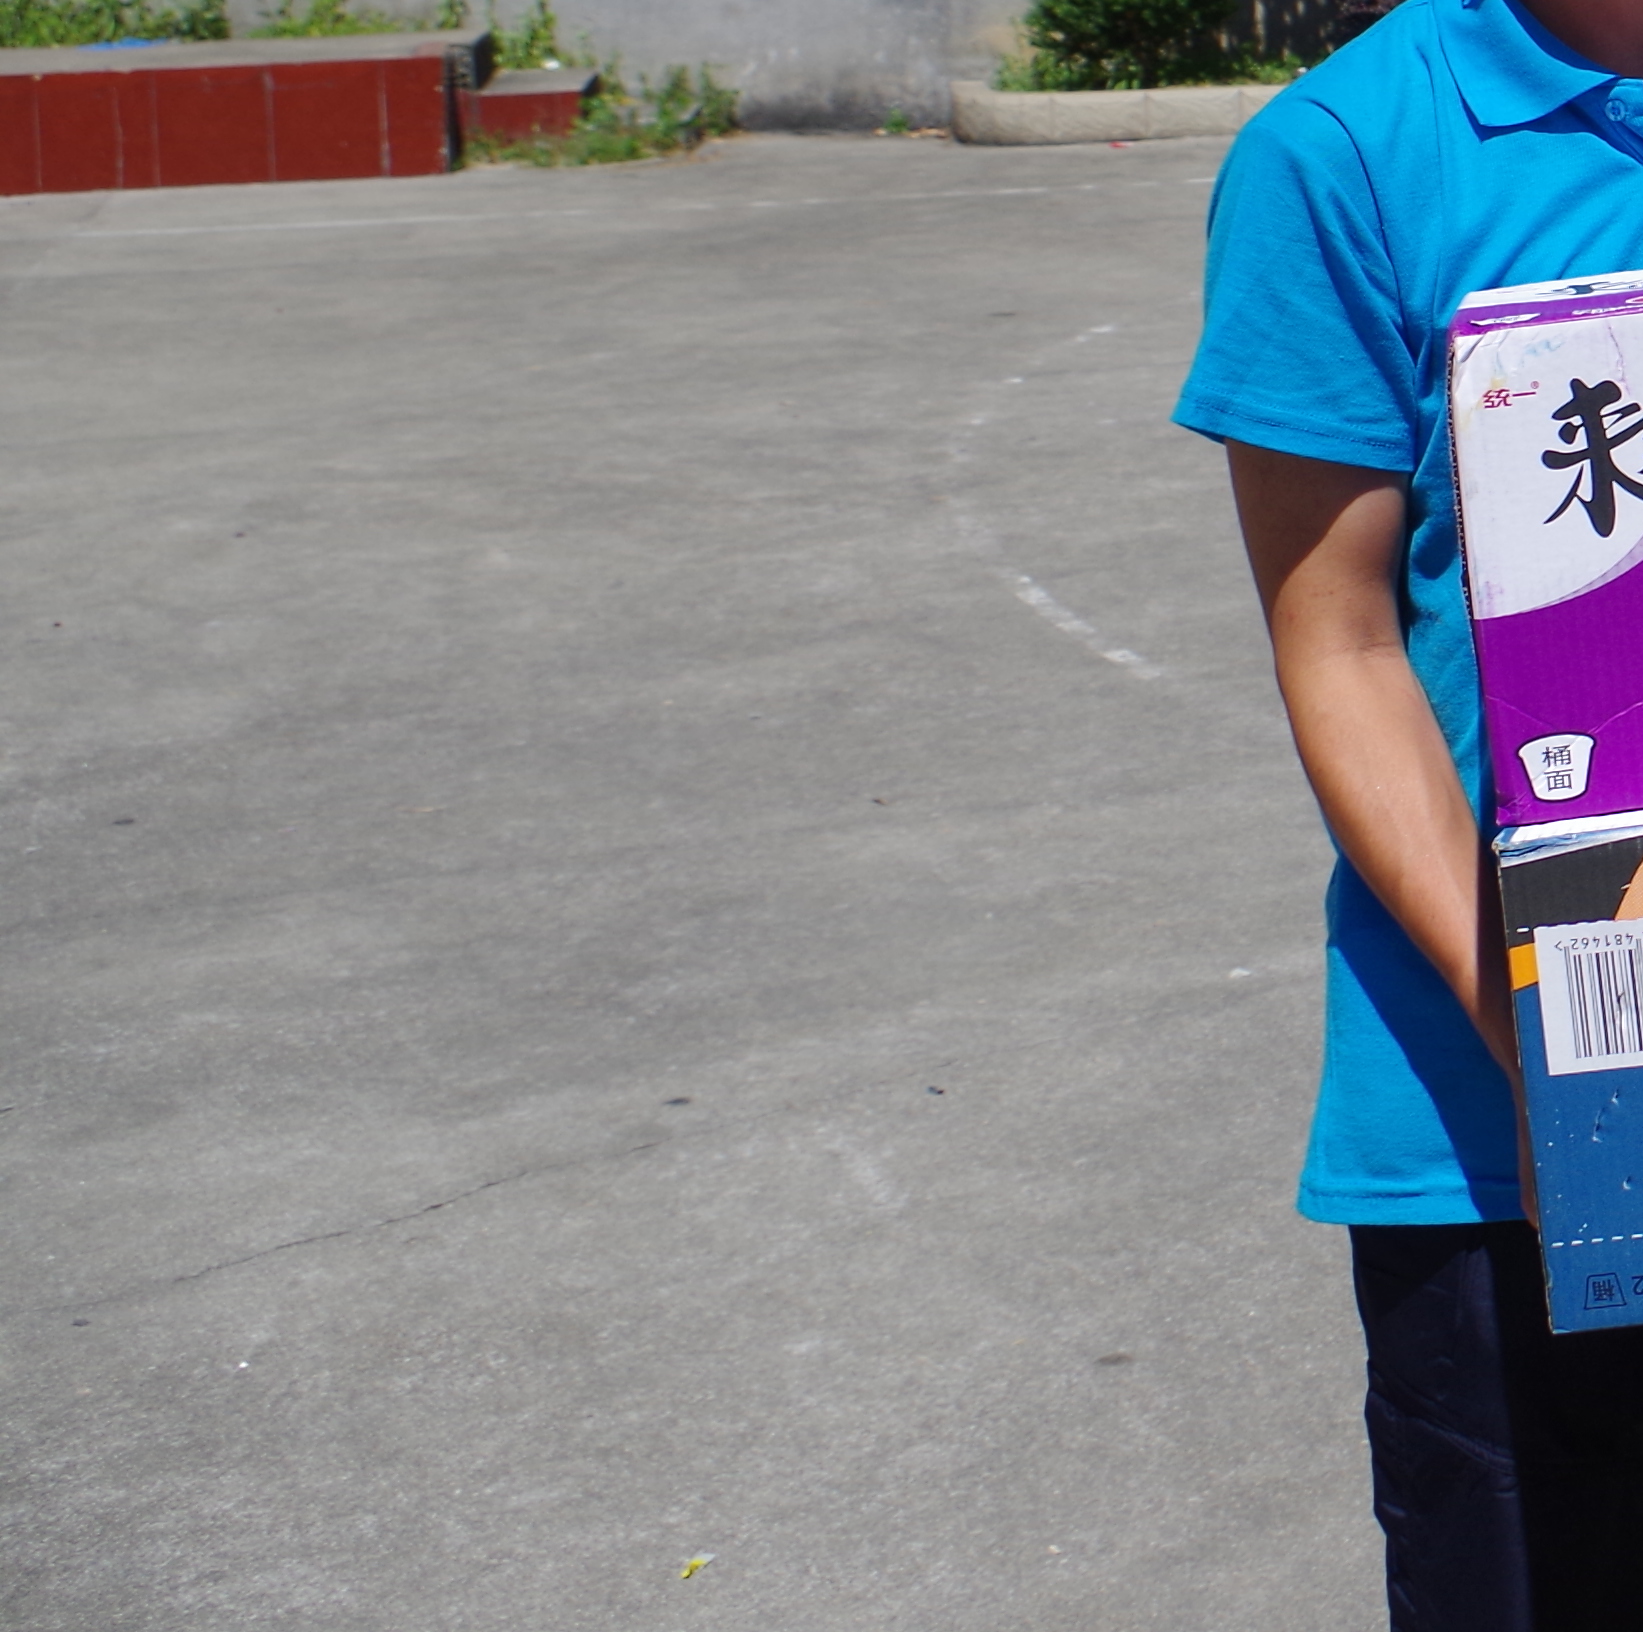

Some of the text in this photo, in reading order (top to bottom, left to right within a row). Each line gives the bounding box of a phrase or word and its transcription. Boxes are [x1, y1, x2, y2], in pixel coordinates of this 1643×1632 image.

[1483, 388, 1537, 409] 统一
[1542, 745, 1574, 793] 桶面
[1569, 932, 1634, 950] 481462
